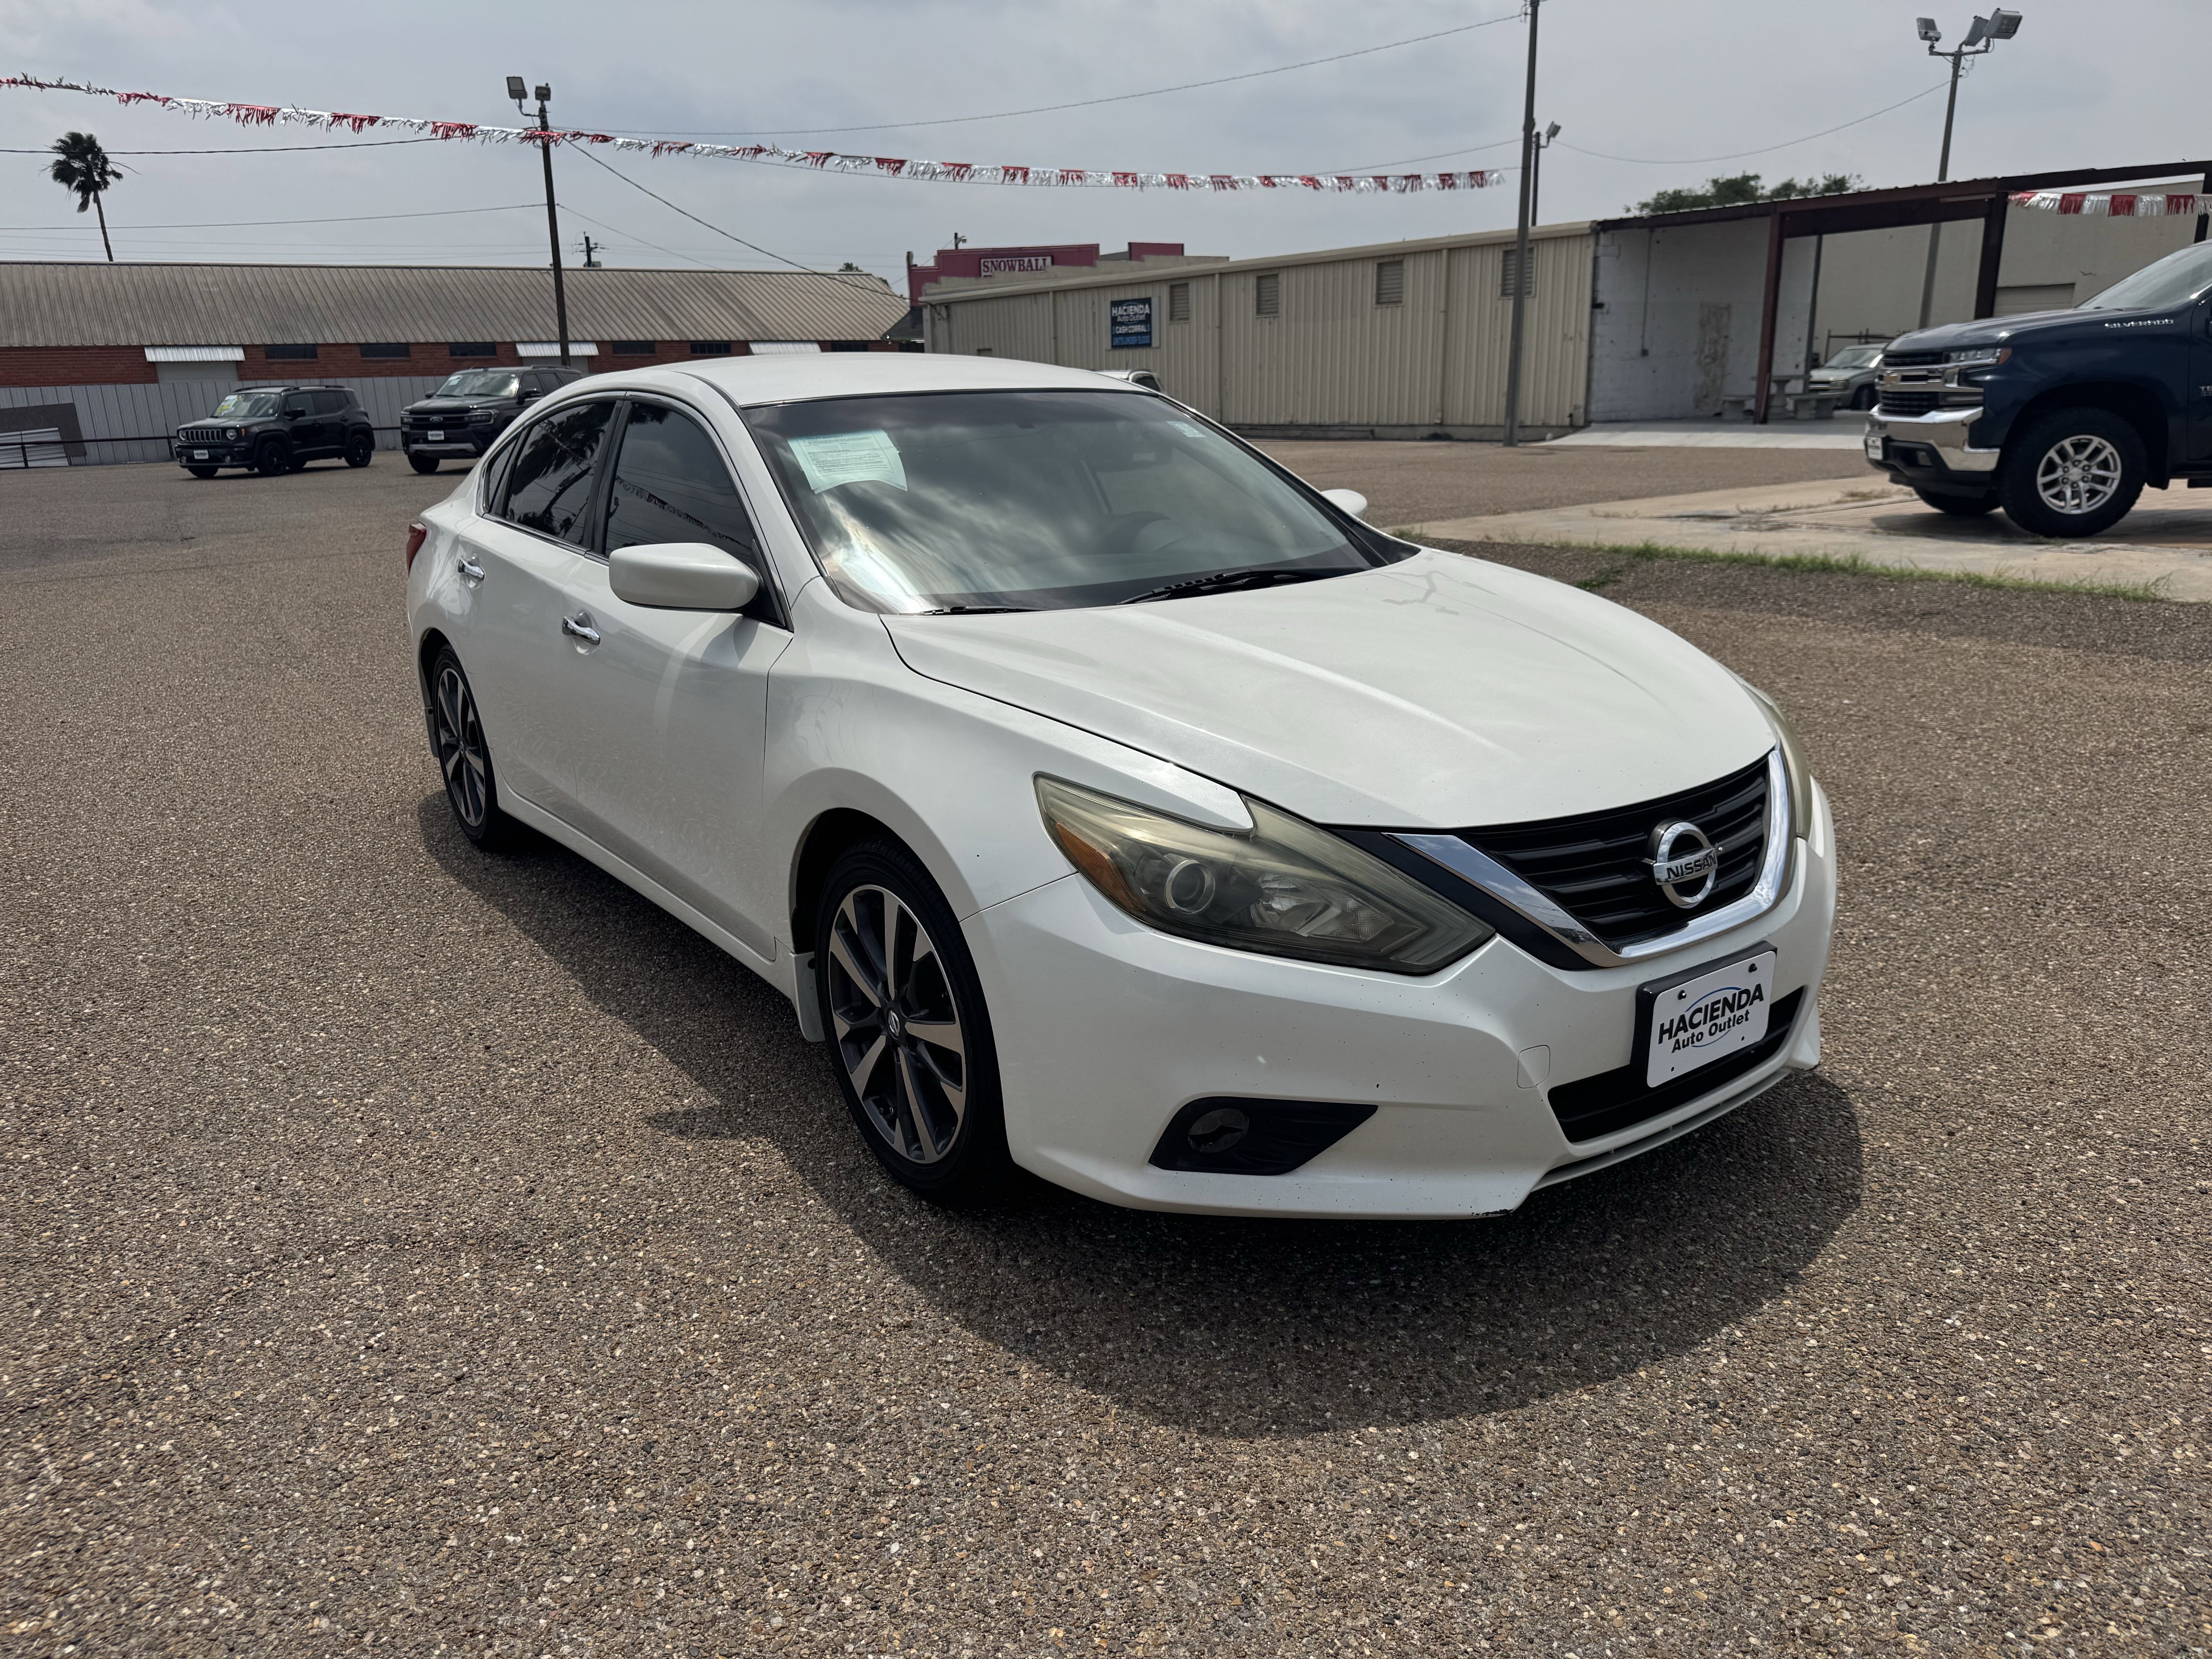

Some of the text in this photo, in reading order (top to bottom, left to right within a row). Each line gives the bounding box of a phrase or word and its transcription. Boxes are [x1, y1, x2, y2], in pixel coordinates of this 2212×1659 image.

[1112, 304, 1150, 316] HACIENDA
[2104, 319, 2174, 329] SILVERADO
[1666, 853, 1716, 879] NISSAN
[1658, 983, 1764, 1045] HACIENDA
[1671, 1009, 1750, 1053] Auto Outlet
